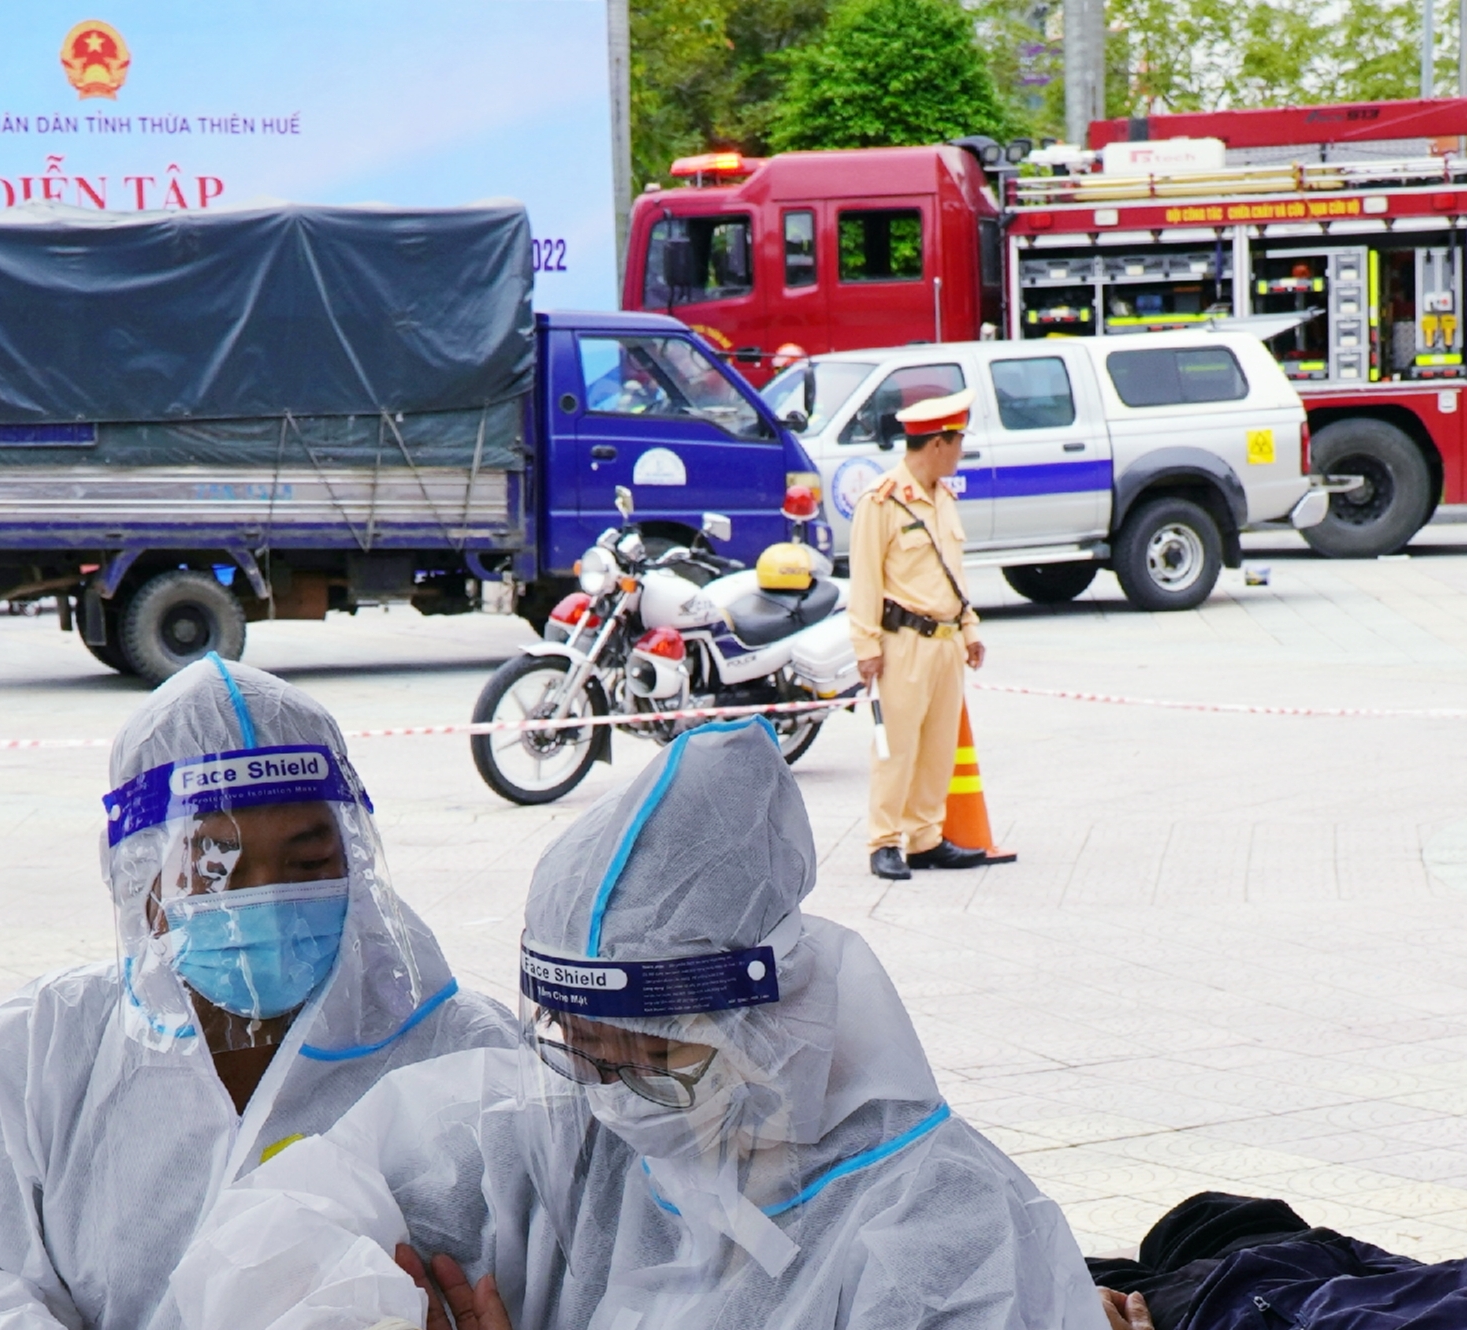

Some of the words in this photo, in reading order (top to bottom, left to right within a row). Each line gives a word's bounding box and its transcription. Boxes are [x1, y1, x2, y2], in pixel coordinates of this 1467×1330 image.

[36, 113, 79, 134] DÂN
[84, 109, 132, 134] TỈNH
[138, 112, 190, 134] THỪA
[198, 113, 255, 134] THIÊN
[262, 110, 301, 134] HUẾ
[532, 239, 567, 272] 022
[182, 768, 237, 789] Face
[248, 758, 319, 778] Shield
[524, 957, 550, 979] Face
[554, 967, 606, 987] Shield
